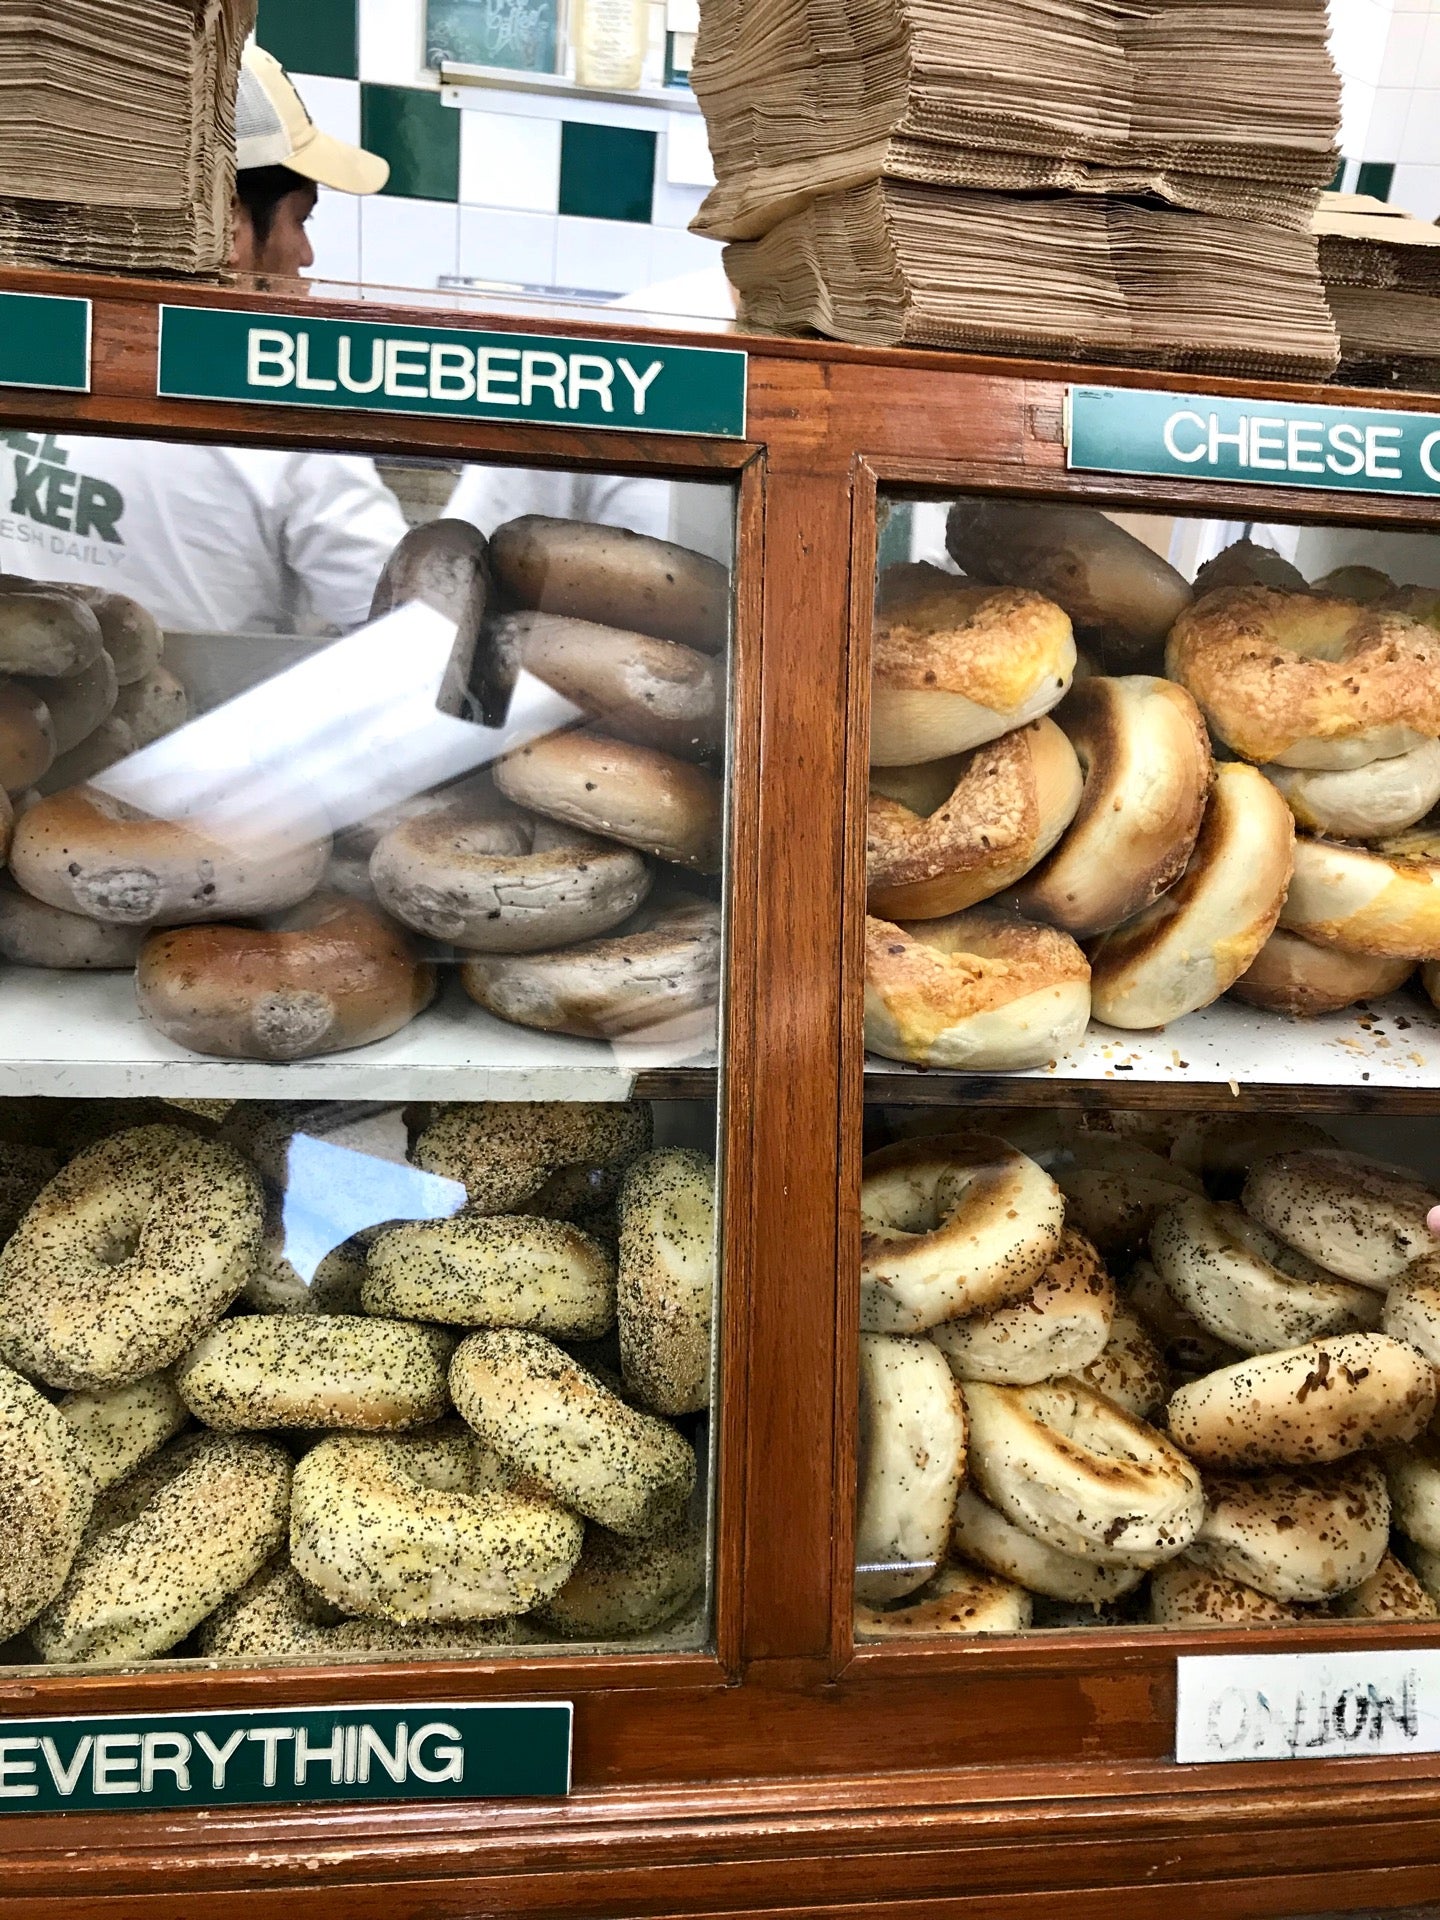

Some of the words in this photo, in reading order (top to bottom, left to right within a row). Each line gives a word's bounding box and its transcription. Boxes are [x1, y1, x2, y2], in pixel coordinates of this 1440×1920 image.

[247, 328, 664, 415] BLUEBERRY
[1164, 411, 1403, 479] CHEESE
[50, 535, 126, 567] DAILY
[1207, 1667, 1419, 1750] ONION
[0, 1722, 464, 1798] EVERYTHING
